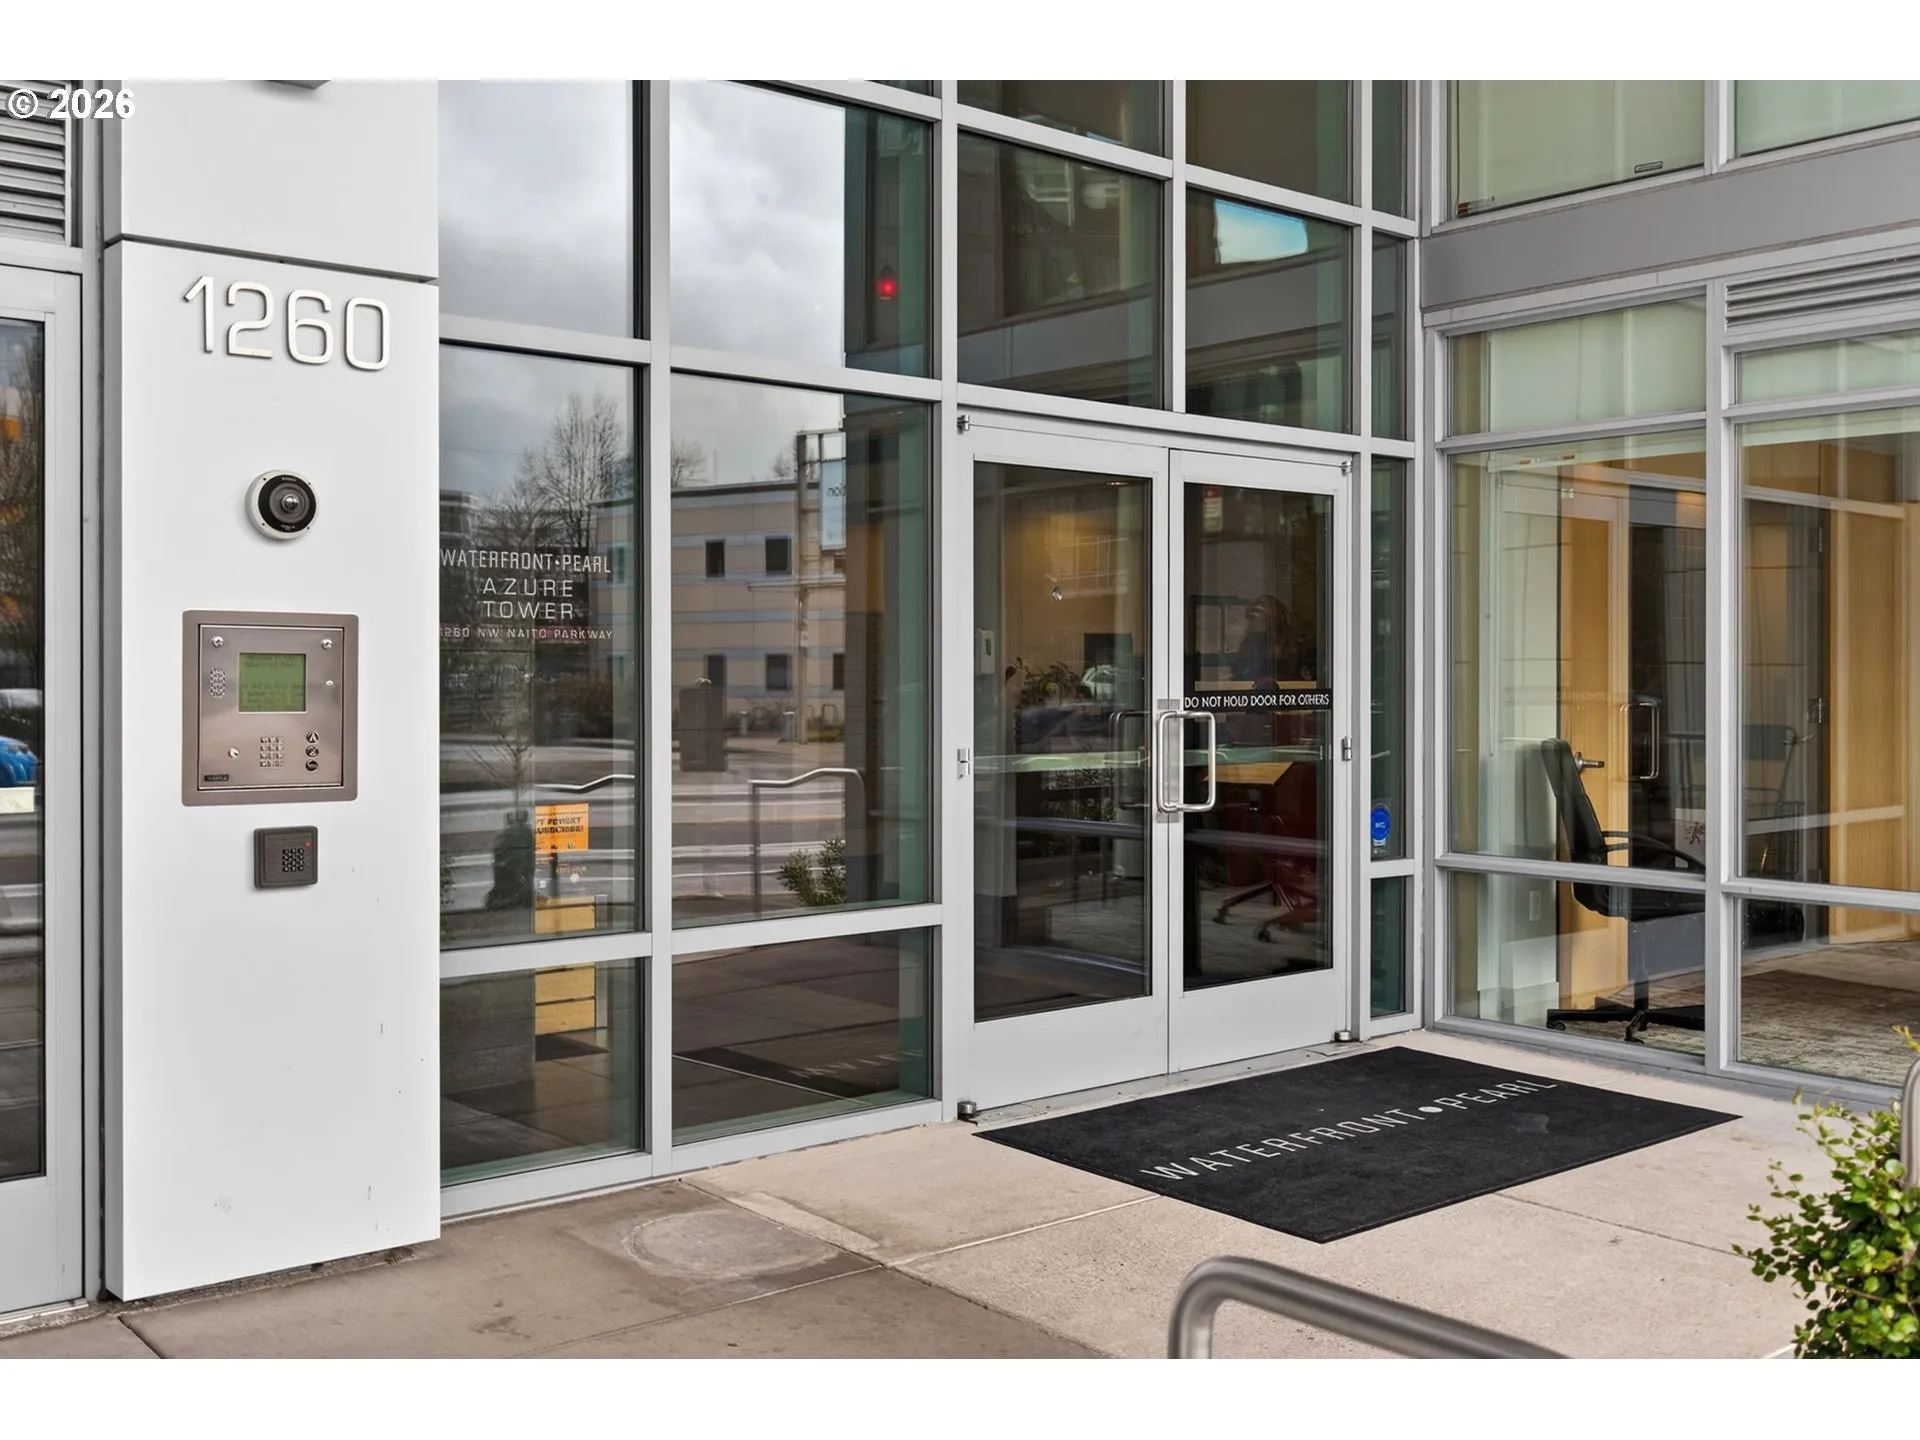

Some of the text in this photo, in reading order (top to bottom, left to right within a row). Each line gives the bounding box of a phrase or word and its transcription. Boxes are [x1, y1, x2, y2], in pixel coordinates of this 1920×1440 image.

[182, 274, 391, 372] 1260
[483, 576, 574, 597] AZURE
[482, 600, 574, 620] TOWER
[477, 626, 500, 639] NW
[507, 627, 548, 639] NAITO
[554, 628, 613, 641] PARKWAY
[1184, 693, 1330, 708] DO NOT HOLD DOOR FOR OTHERS
